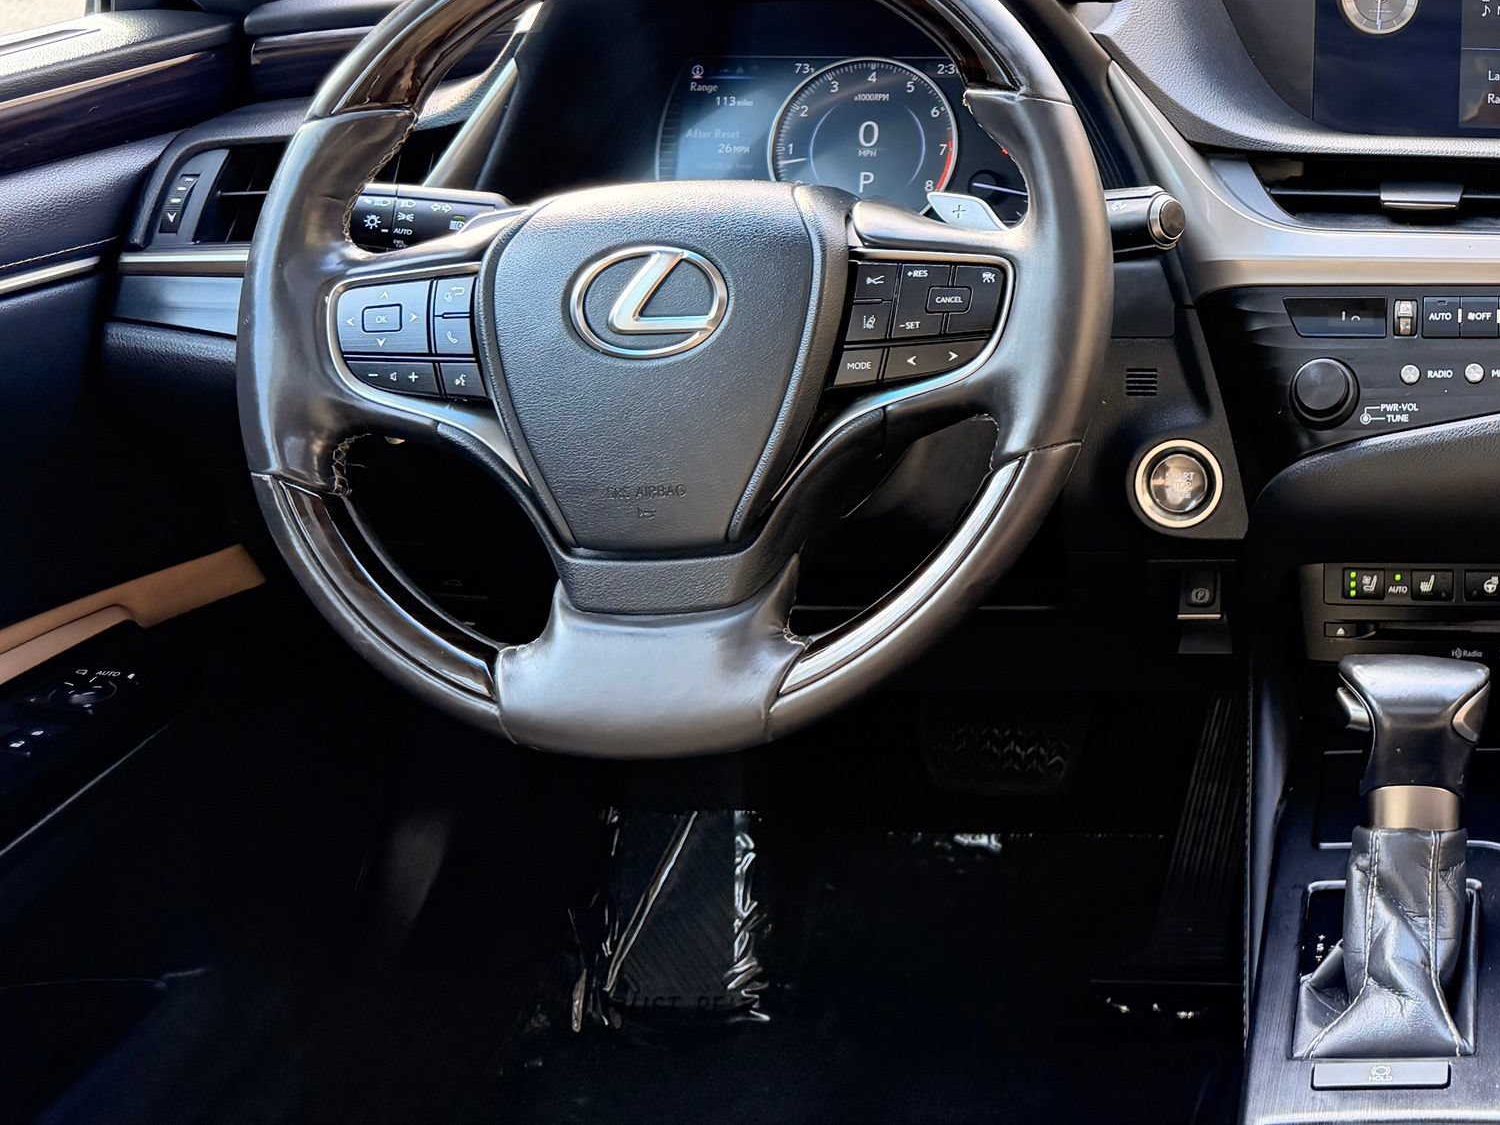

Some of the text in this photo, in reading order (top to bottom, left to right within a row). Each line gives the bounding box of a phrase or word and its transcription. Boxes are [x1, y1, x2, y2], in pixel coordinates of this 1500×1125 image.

[867, 72, 877, 82] 4
[690, 81, 719, 94] Range
[830, 81, 839, 93] 3
[906, 81, 915, 93] 5
[716, 96, 737, 107] 113
[800, 106, 809, 117] 2
[930, 107, 940, 118] 6
[686, 129, 740, 139] After Reset
[858, 120, 879, 148] 0
[718, 143, 732, 154] 26
[939, 144, 947, 156] 7
[859, 171, 875, 194] P
[924, 180, 934, 192] 8
[393, 227, 413, 236] AUTO
[935, 296, 963, 304] CANCEL
[375, 315, 388, 324] OK
[1428, 312, 1452, 321] AUTO
[1476, 312, 1493, 320] OFF
[847, 361, 872, 371] MODE
[1427, 369, 1454, 379] RADIO
[1386, 414, 1410, 423] TUNE
[636, 483, 687, 498] AIRBAG
[1388, 585, 1408, 594] AUTO
[1463, 649, 1483, 658] Radio
